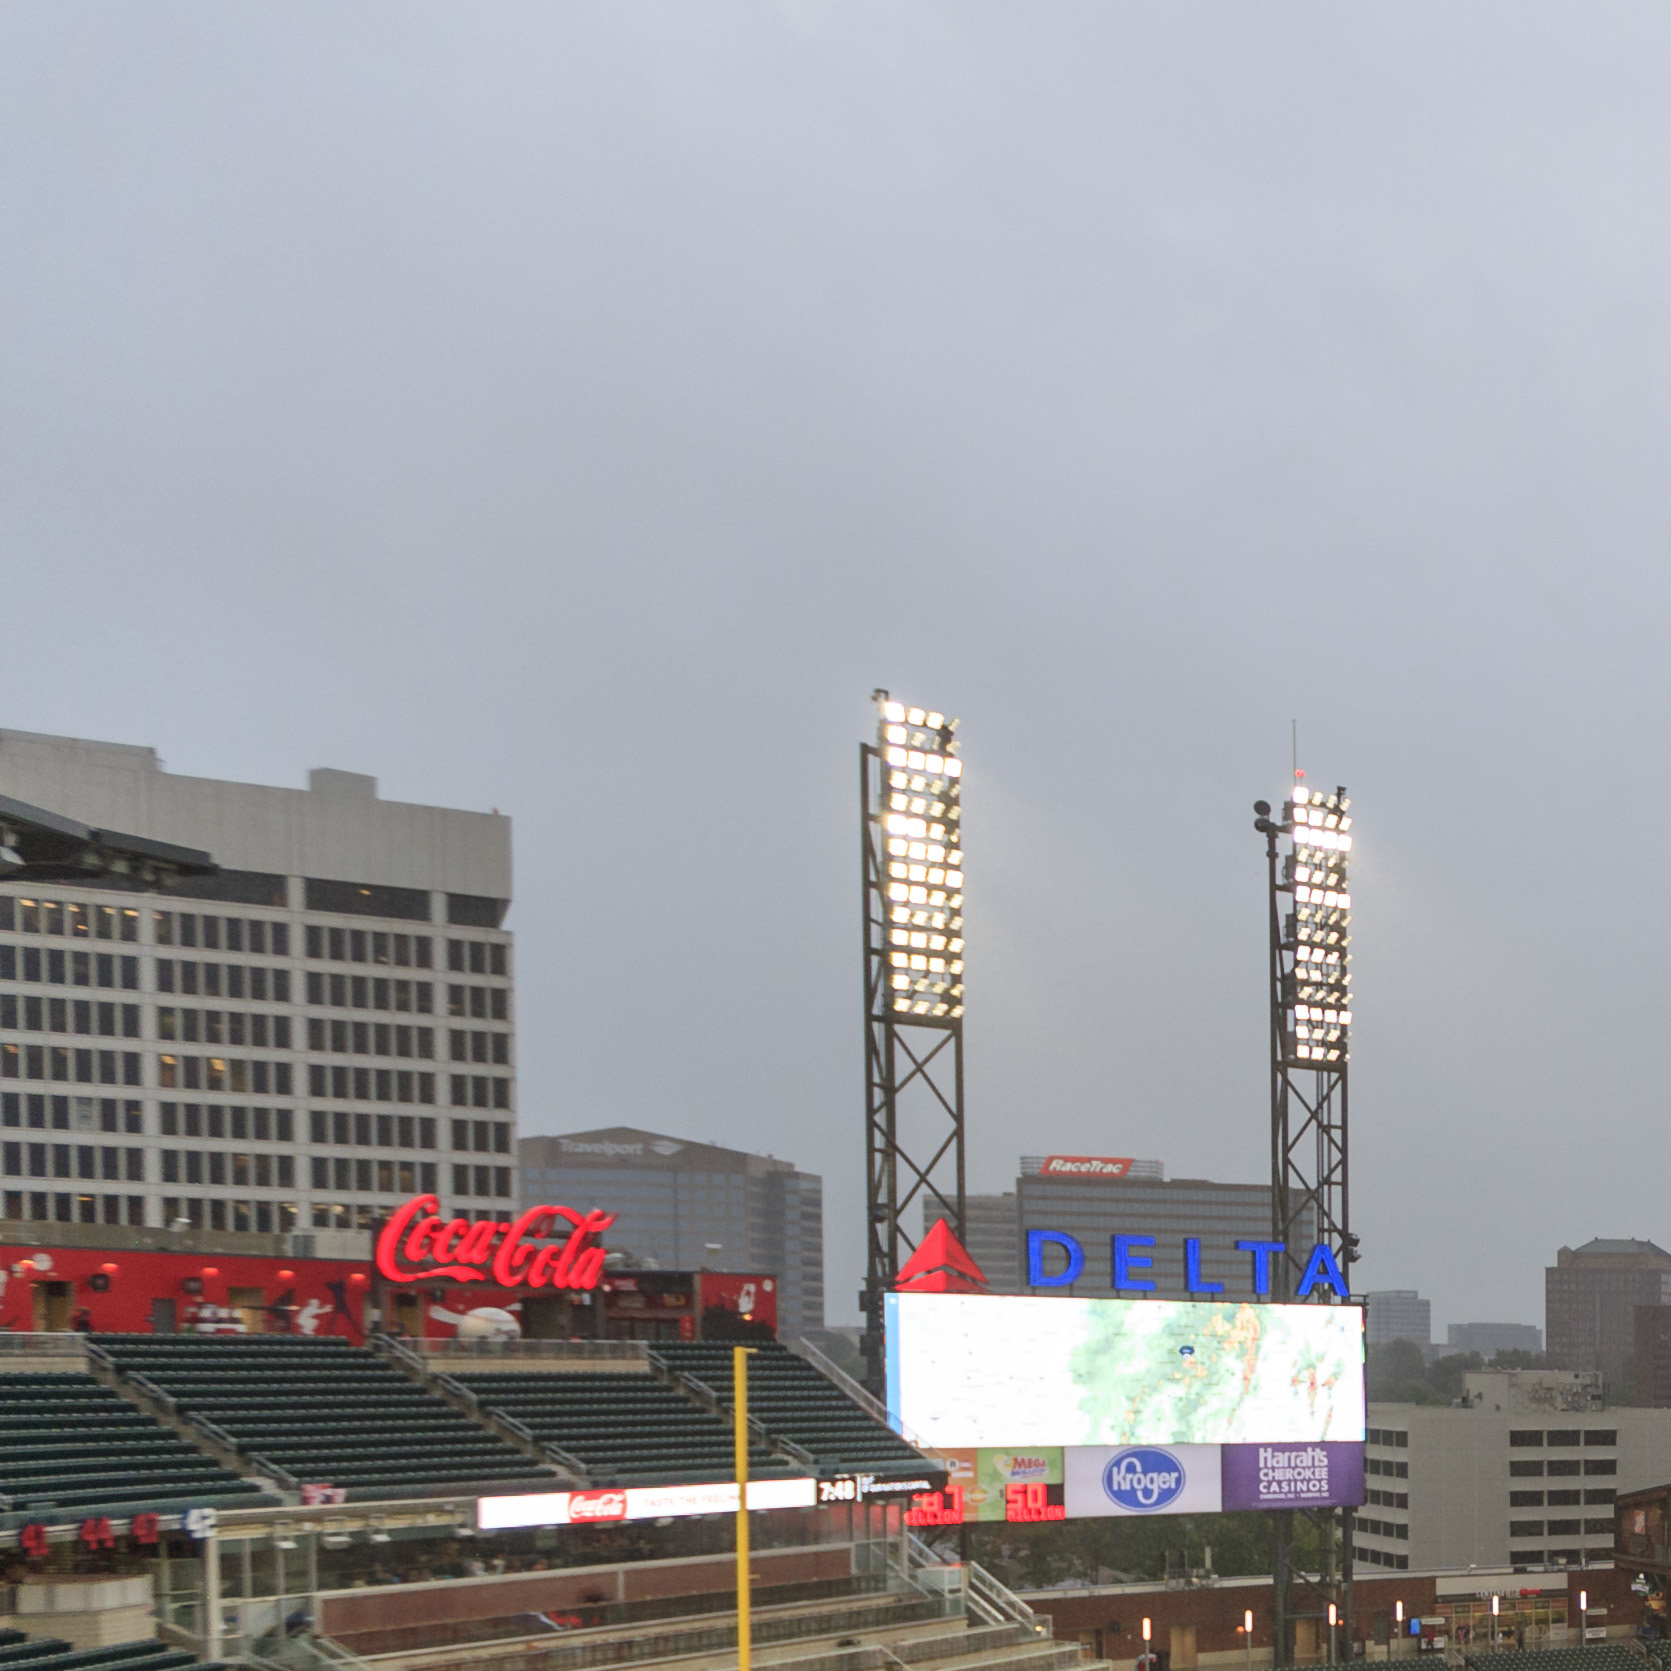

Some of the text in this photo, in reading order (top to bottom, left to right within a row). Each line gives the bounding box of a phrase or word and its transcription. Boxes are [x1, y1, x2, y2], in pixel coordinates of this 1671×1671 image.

[557, 1137, 644, 1156] Travelport
[1047, 1158, 1125, 1175] RaceTrac
[1027, 1228, 1350, 1298] DELTA
[1012, 1456, 1046, 1469] MEGA
[1259, 1446, 1329, 1469] Harrah's
[1112, 1457, 1179, 1505] Kroger
[1259, 1468, 1329, 1481] CHEROKEE
[819, 1479, 855, 1501] 7:48
[1006, 1482, 1048, 1509] 50
[1259, 1480, 1329, 1493] CASINOS
[1006, 1504, 1066, 1522] MILLION
